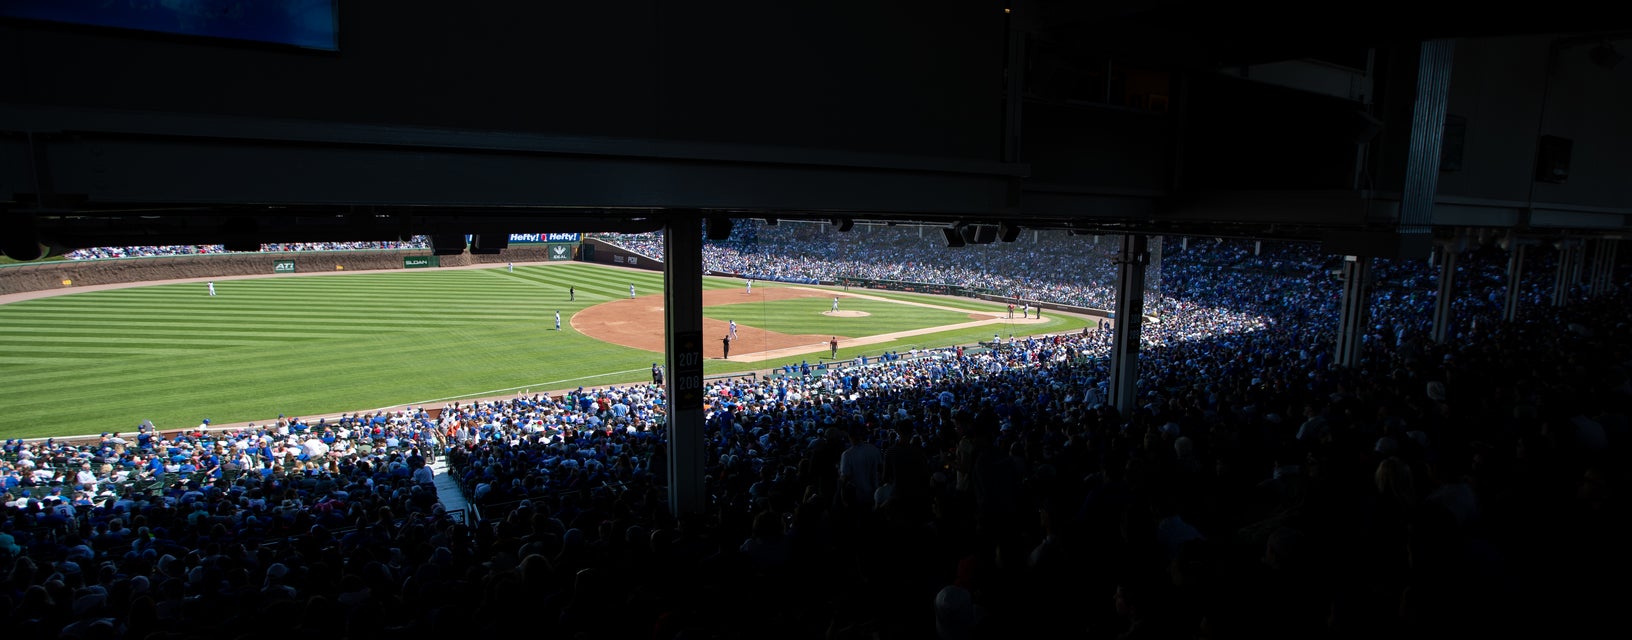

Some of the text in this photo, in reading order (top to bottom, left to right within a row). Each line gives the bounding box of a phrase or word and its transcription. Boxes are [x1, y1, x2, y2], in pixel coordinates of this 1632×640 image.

[510, 233, 539, 242] Hefty!
[549, 233, 577, 241] Hefty!
[679, 351, 699, 367] 207
[679, 374, 699, 390] 208
